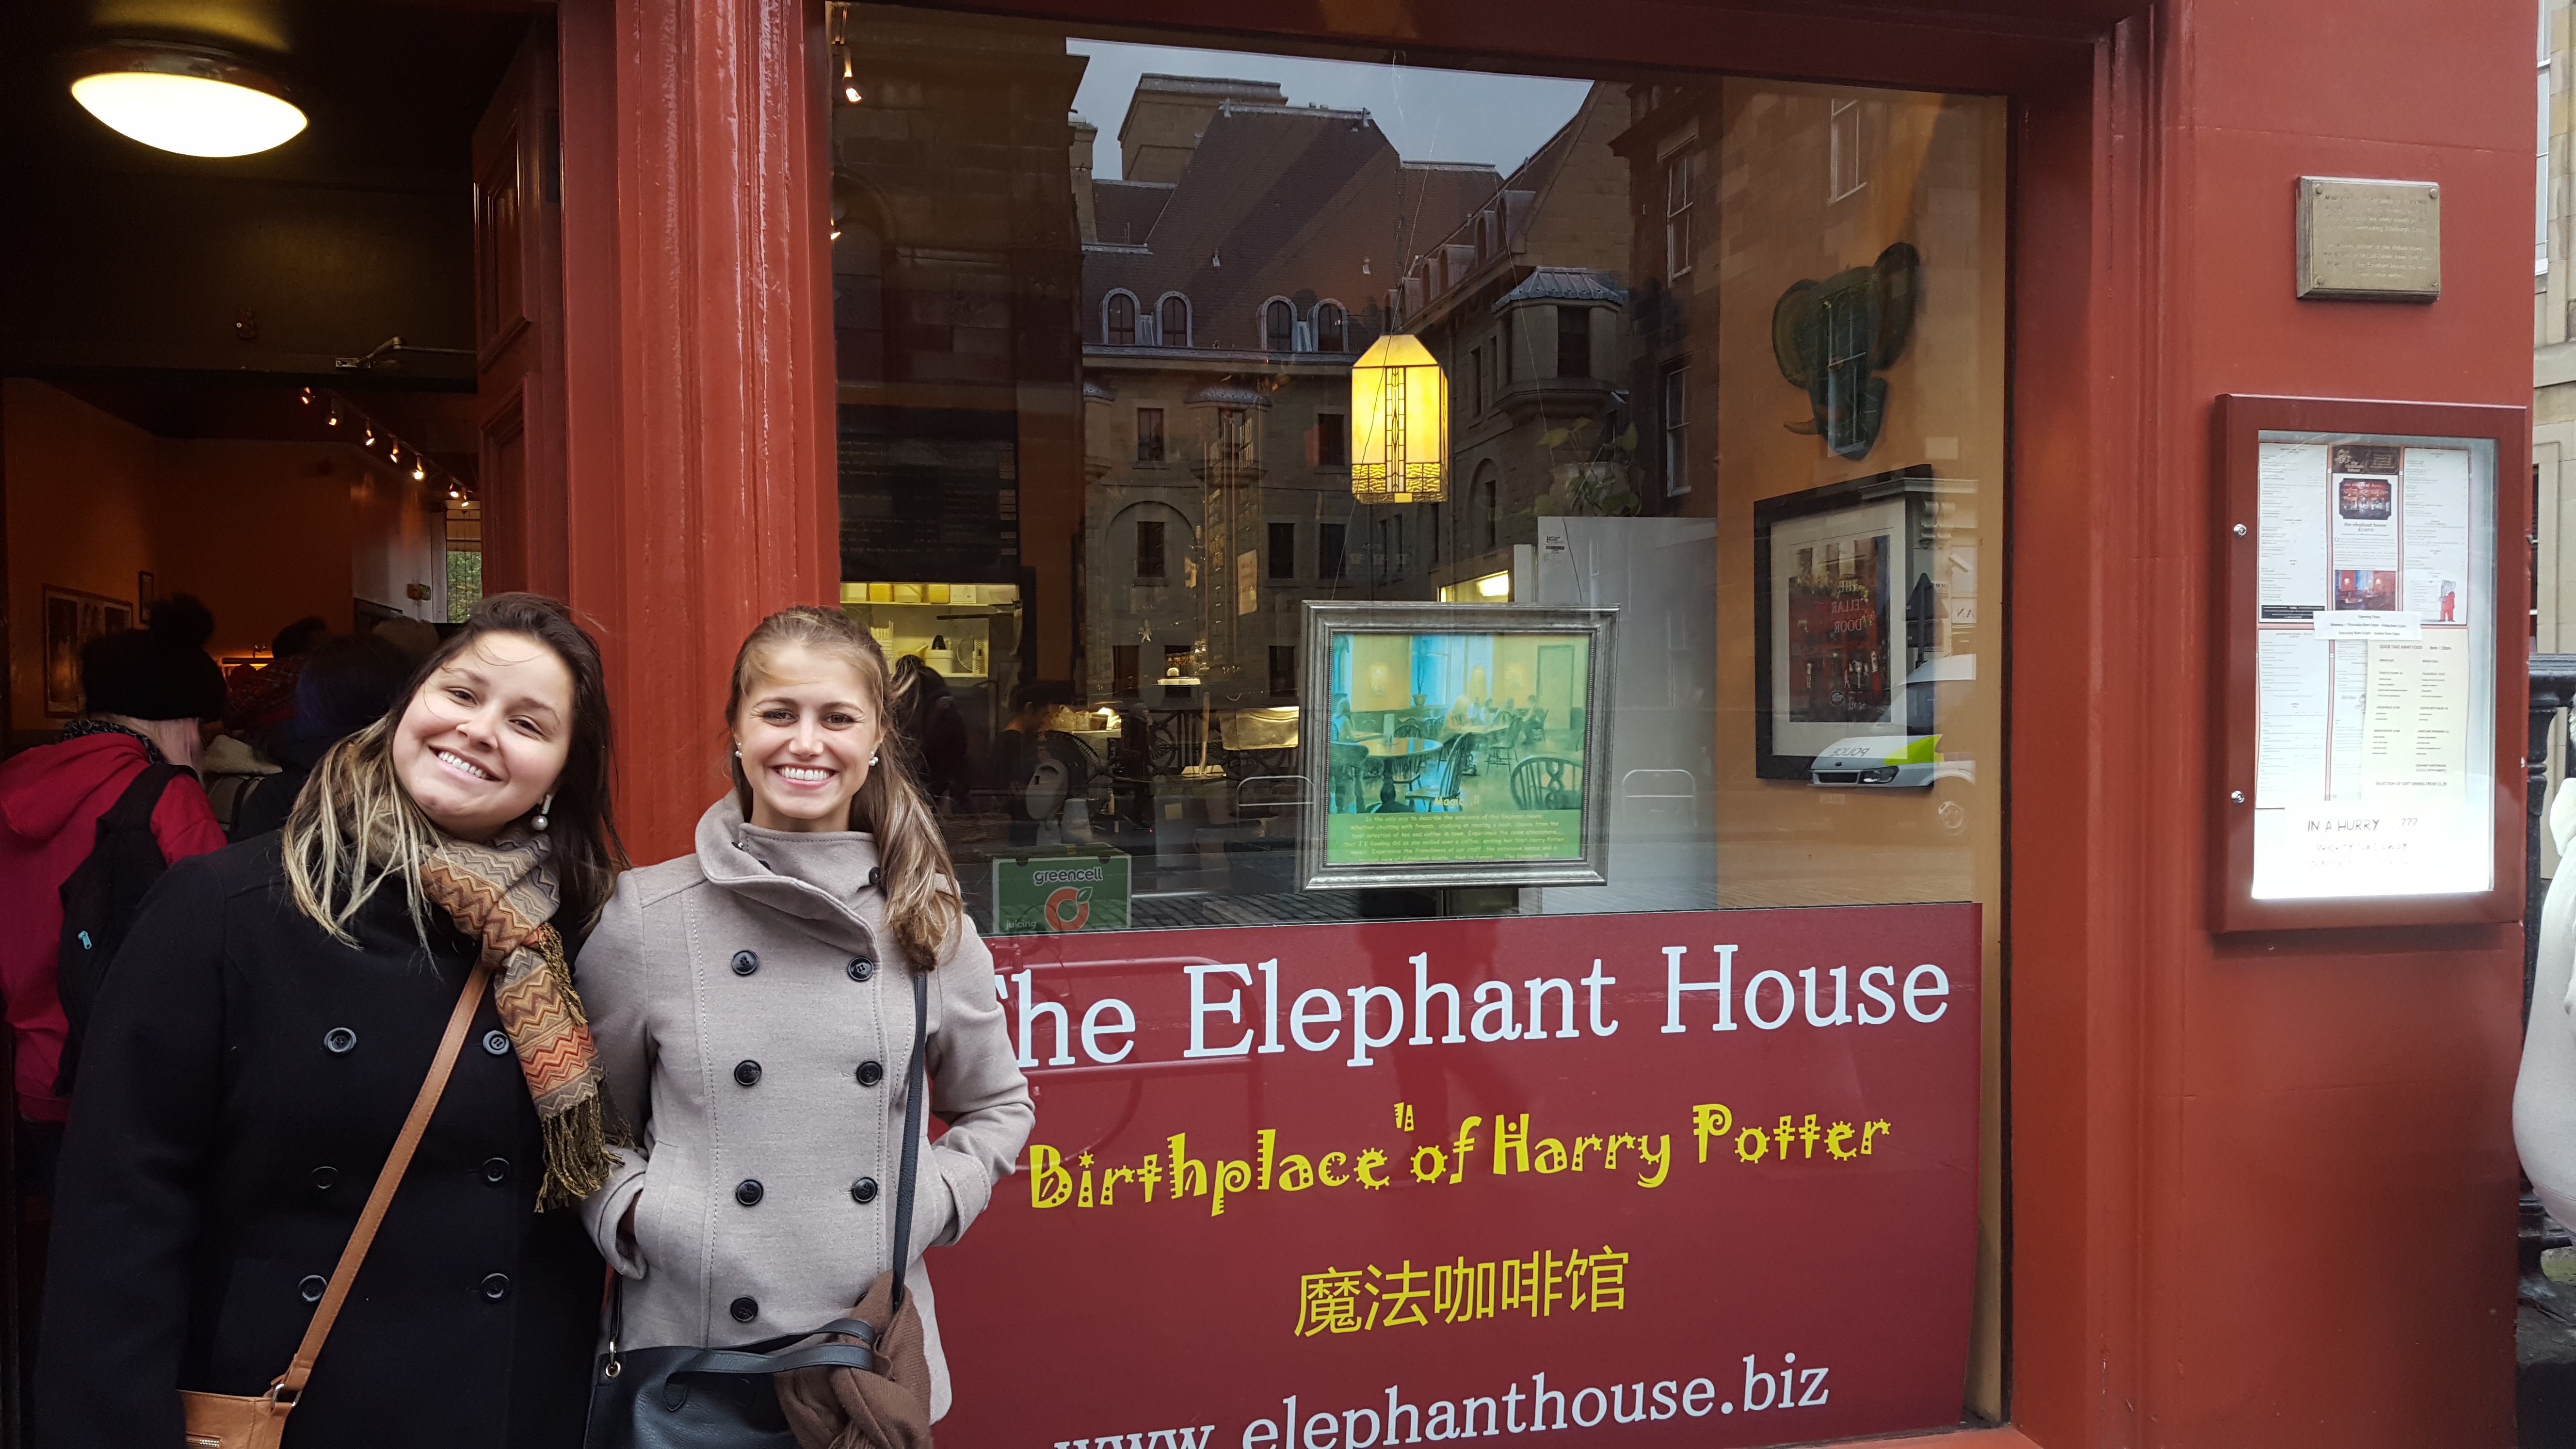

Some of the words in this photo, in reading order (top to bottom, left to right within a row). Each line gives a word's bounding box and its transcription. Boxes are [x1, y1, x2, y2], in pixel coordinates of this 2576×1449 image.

[2307, 820, 2320, 832] IN
[2325, 820, 2332, 833] A
[2338, 819, 2380, 832] HURRY
[1033, 867, 1103, 886] greencell
[1005, 919, 1037, 930] juicing
[995, 969, 1136, 1067] he
[1183, 952, 1618, 1067] Elephant
[1661, 944, 1949, 1033] House
[1410, 1116, 1482, 1184] of
[1493, 1113, 1670, 1188] Harry
[1692, 1103, 1891, 1164] Potter
[1294, 1245, 1629, 1337] 魔法咖啡馆
[1054, 1352, 1829, 1449] welephanthouse.biz
